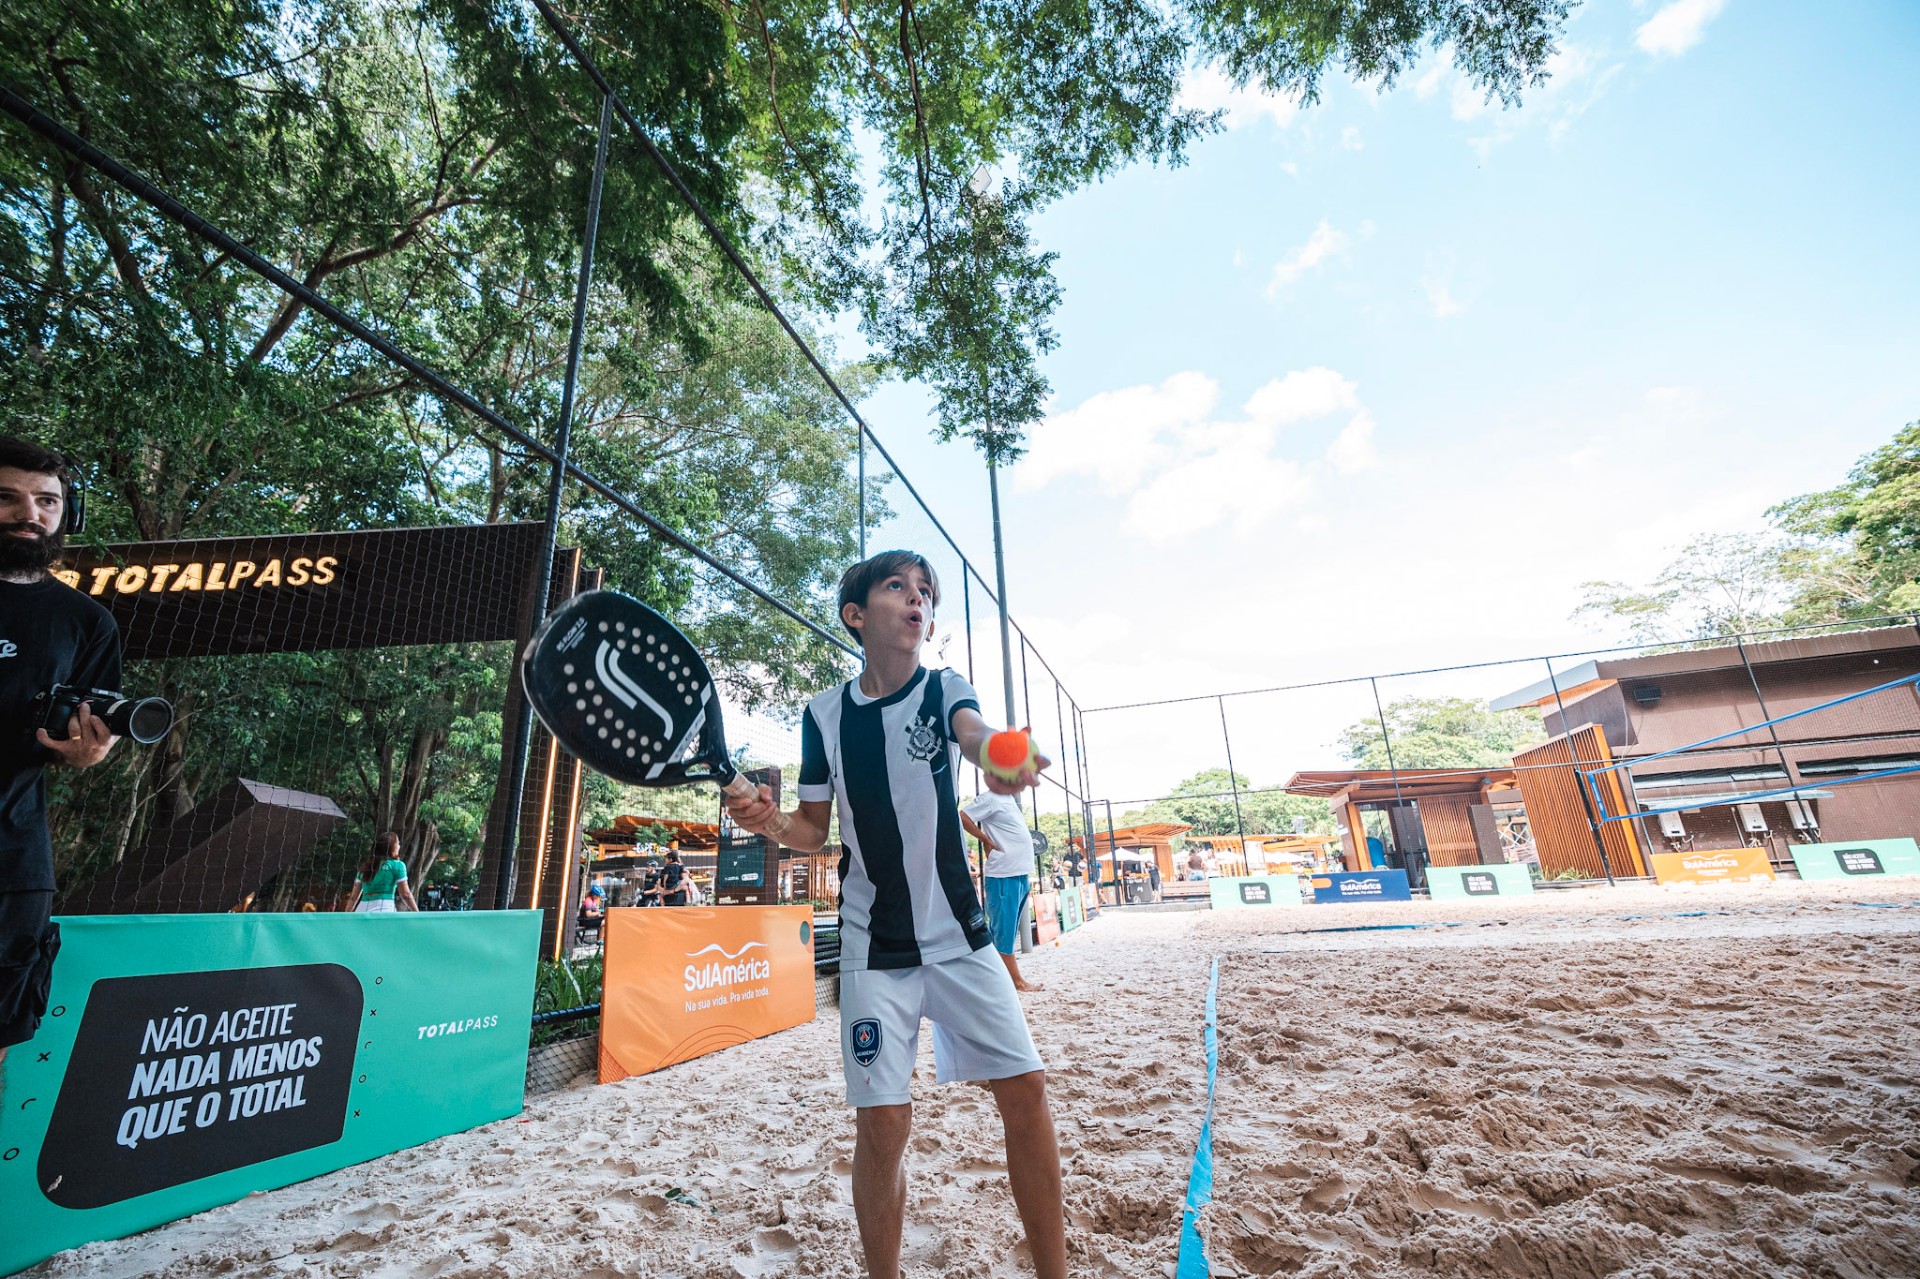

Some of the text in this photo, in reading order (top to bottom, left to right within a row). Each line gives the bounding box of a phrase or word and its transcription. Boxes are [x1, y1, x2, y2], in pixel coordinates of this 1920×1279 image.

[89, 556, 338, 596] TOTALPASS
[684, 957, 770, 992] SulAmérica
[685, 1001, 696, 1013] Na
[698, 999, 711, 1010] sua
[712, 994, 728, 1006] vida.
[730, 992, 741, 1003] Pra
[742, 988, 755, 1000] vida
[140, 1003, 297, 1055] NÃO ACEITE
[417, 1014, 498, 1040] TOTALPASS
[127, 1035, 324, 1100] NADA MENOS
[116, 1074, 307, 1150] QUE O TOTAL
